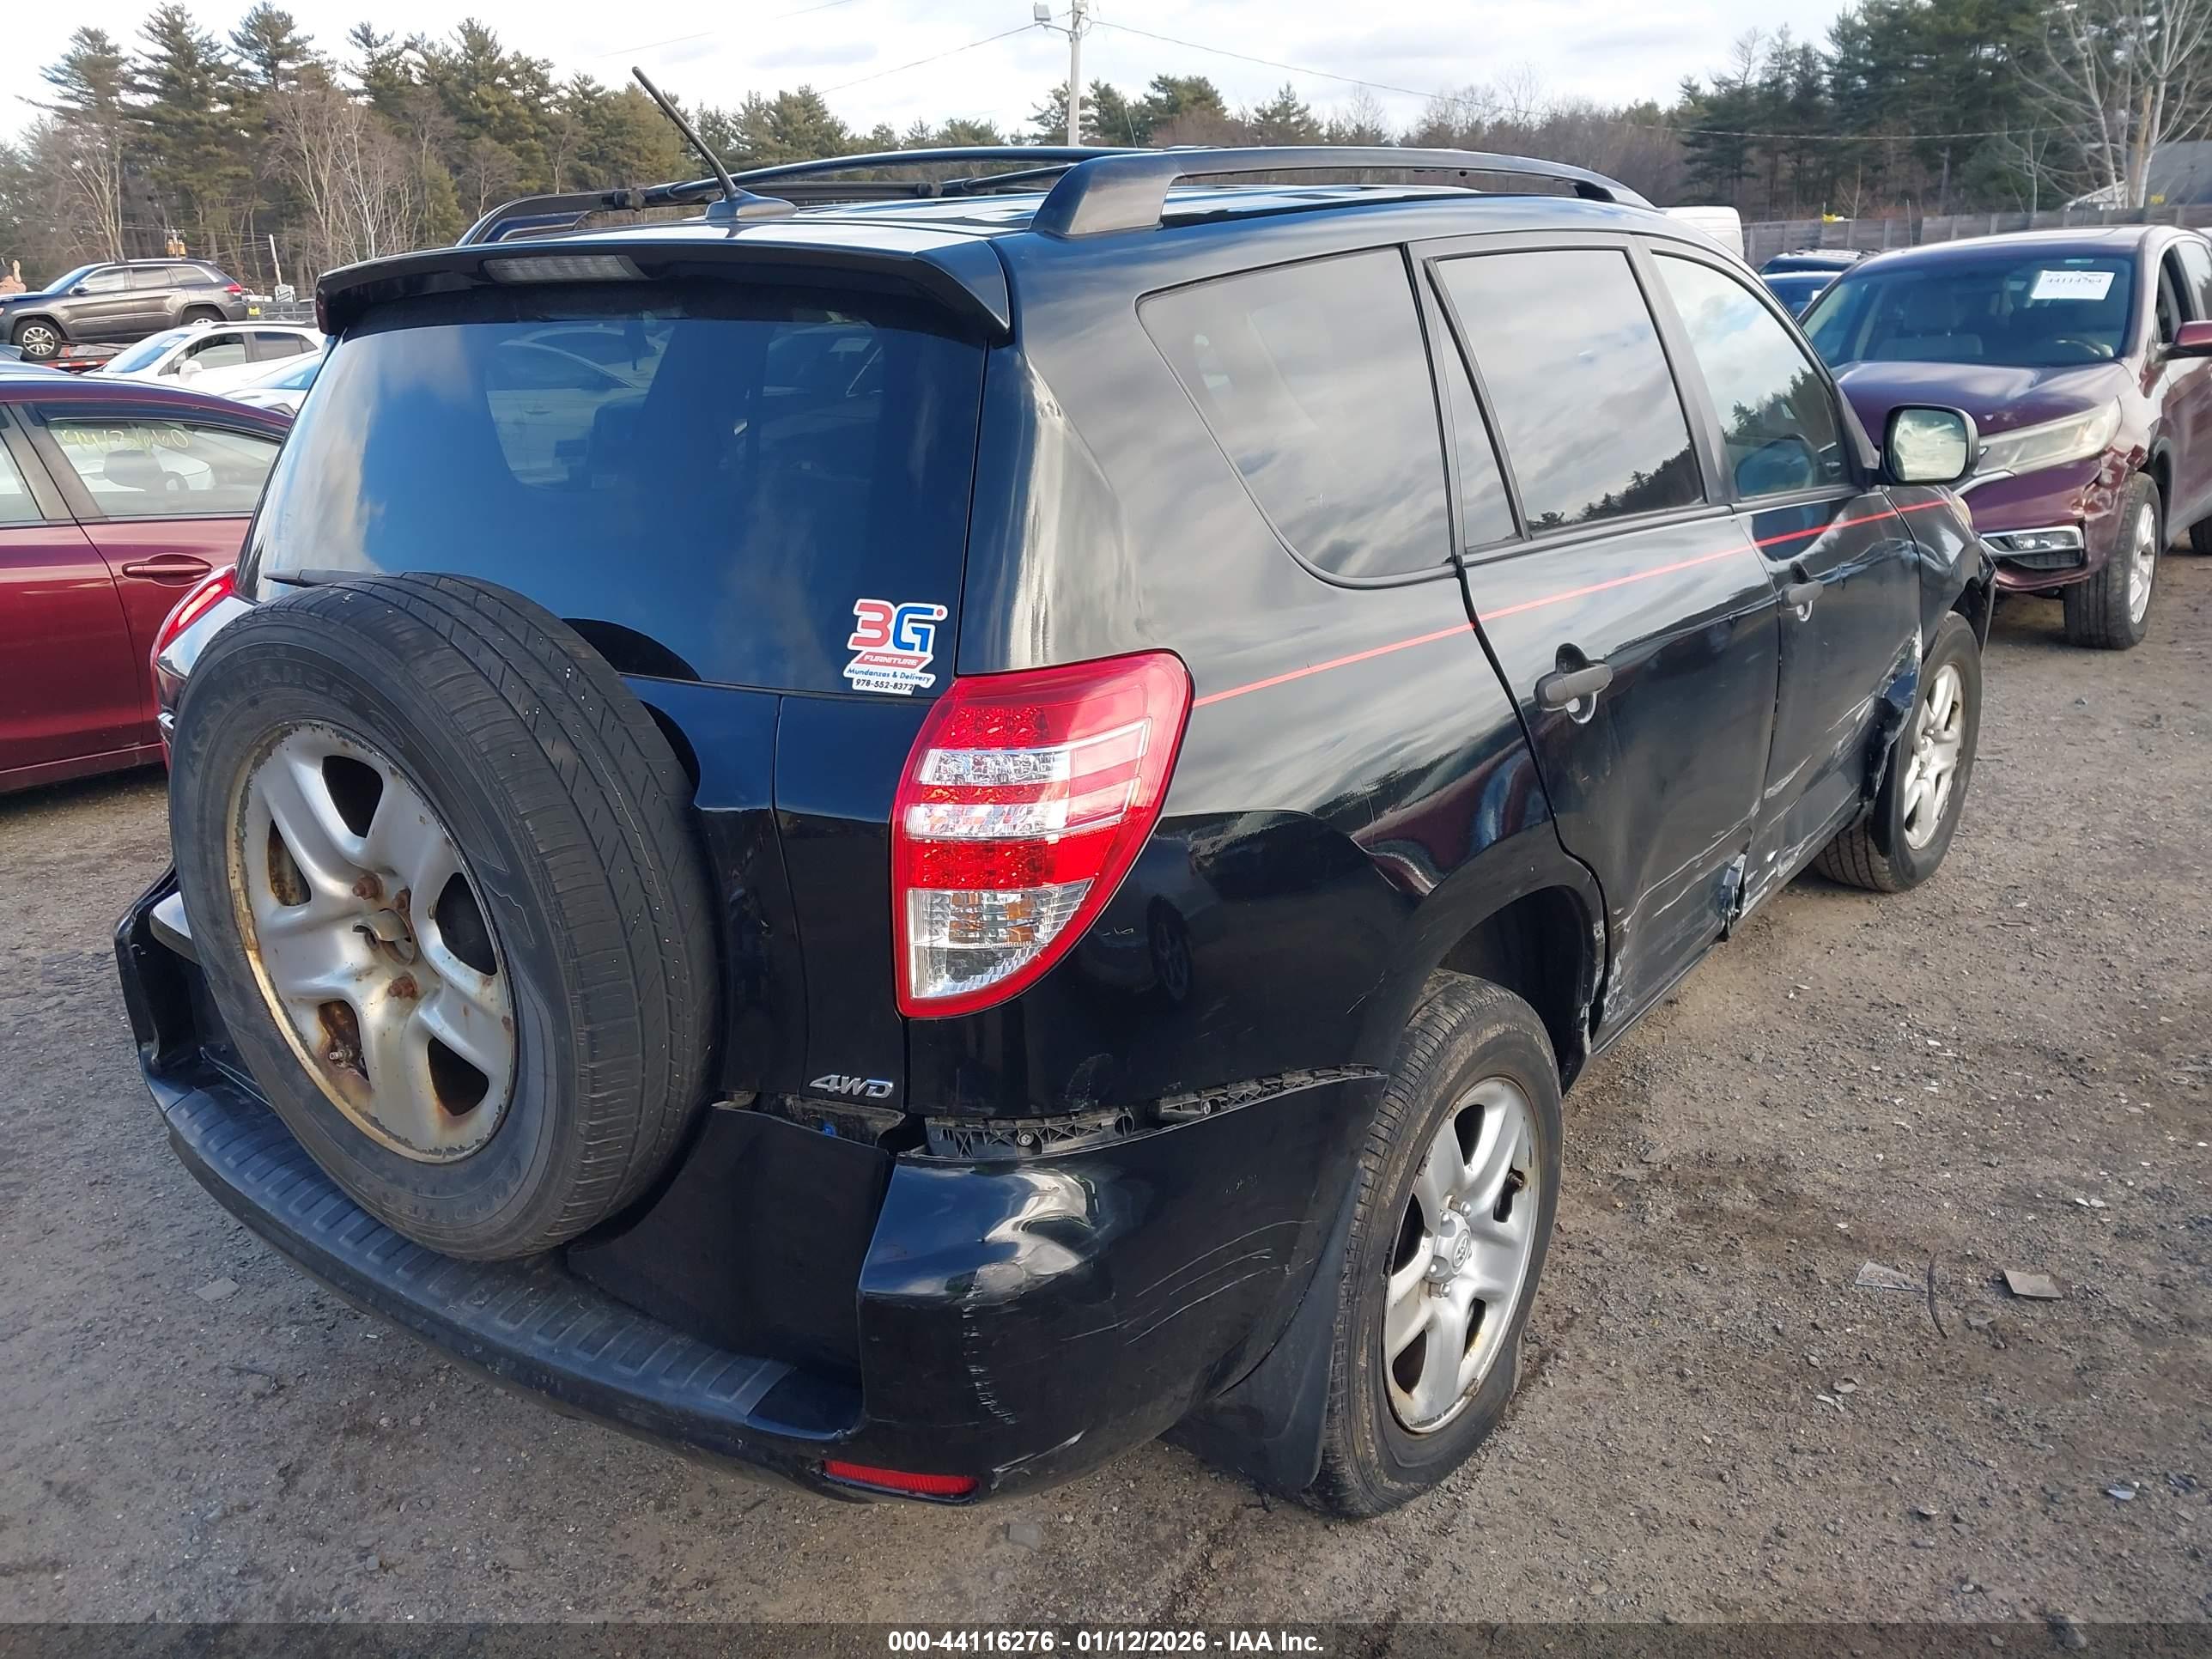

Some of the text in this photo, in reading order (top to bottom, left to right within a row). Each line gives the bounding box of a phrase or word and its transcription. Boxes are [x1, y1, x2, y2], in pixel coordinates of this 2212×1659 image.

[851, 602, 935, 653] 3G
[863, 655, 920, 666] FURNITURE
[847, 668, 890, 678] Mundanzas
[900, 672, 932, 684] Delivery
[855, 678, 915, 691] 978-552-8372
[809, 1074, 893, 1098] 4WD
